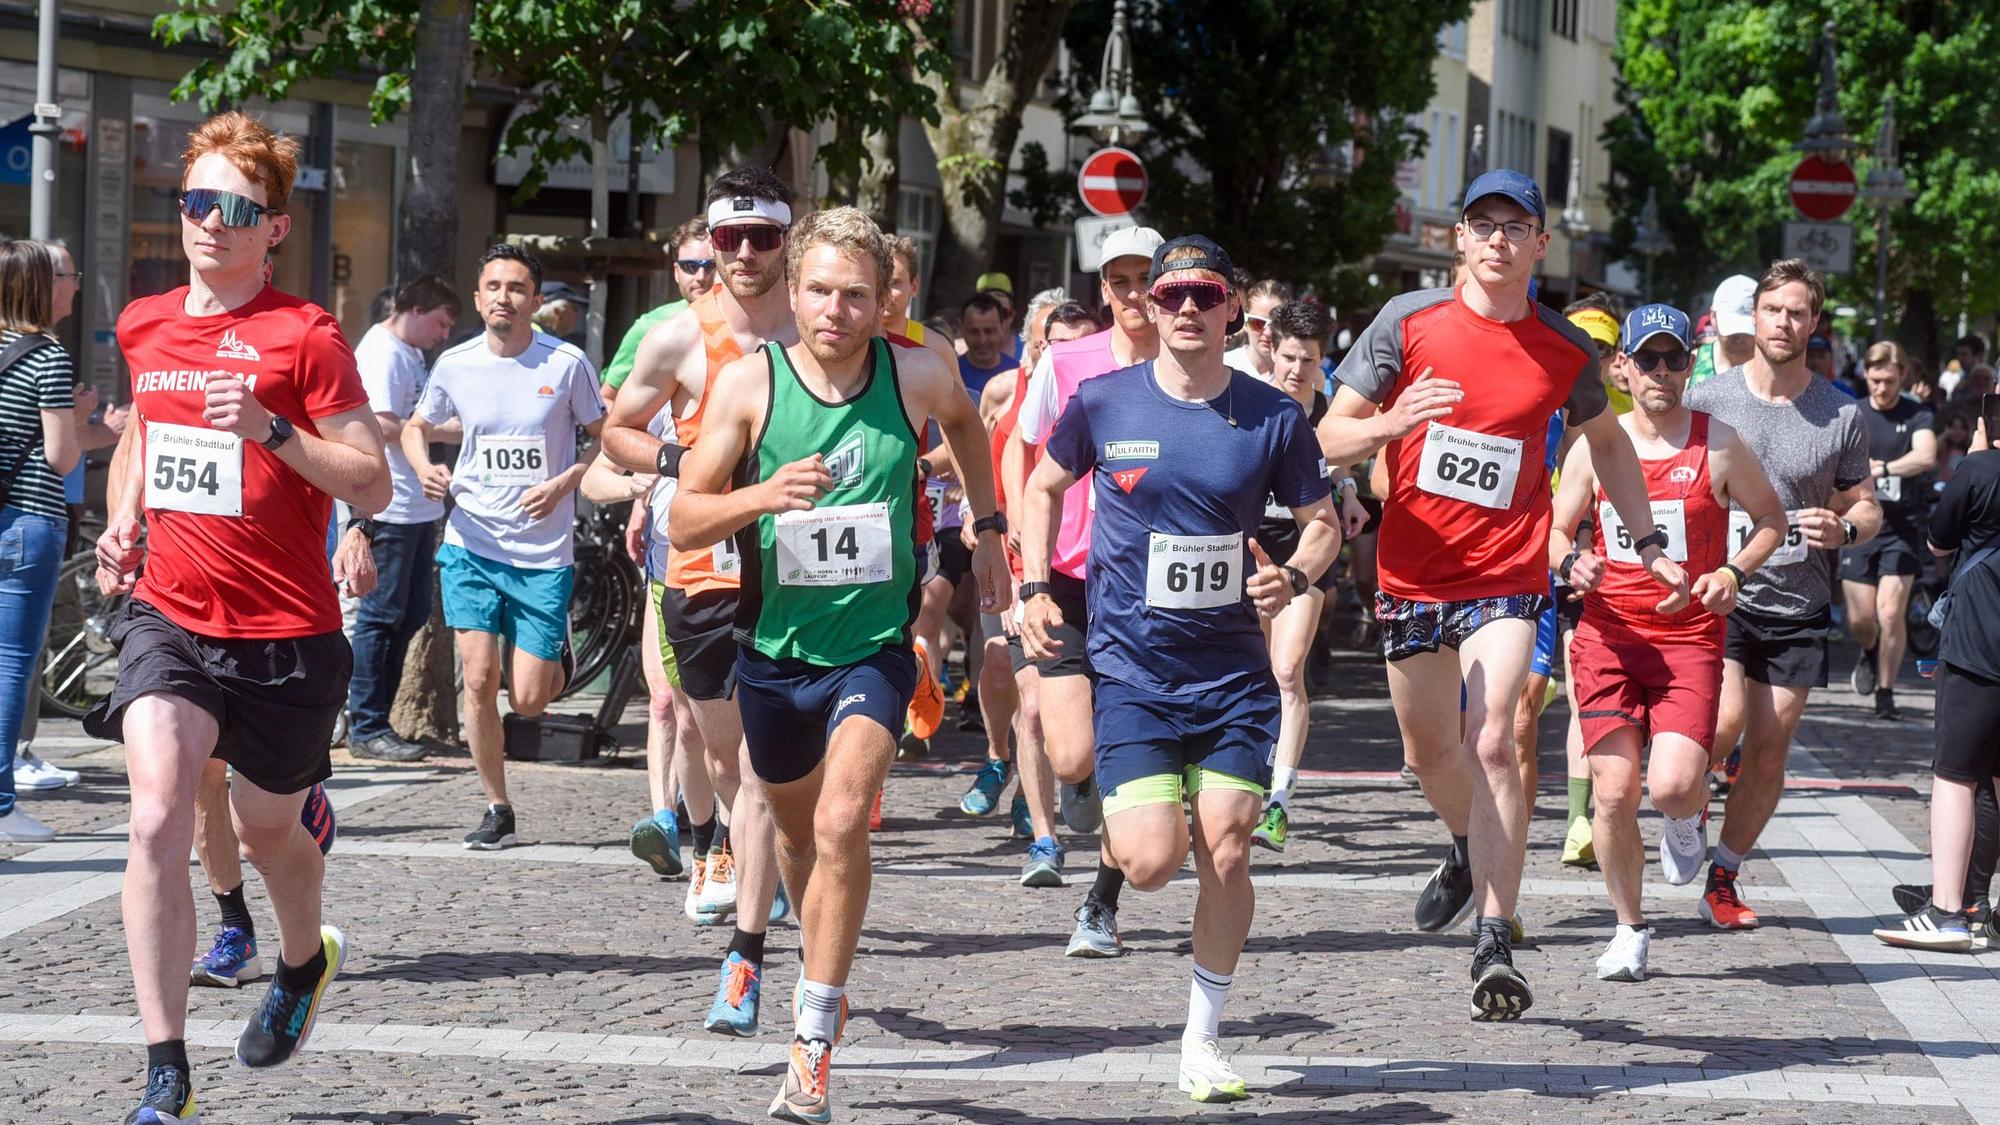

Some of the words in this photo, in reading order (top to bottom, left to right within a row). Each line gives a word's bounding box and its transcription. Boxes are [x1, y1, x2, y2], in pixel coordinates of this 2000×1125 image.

[163, 433, 194, 446] Brühler
[195, 438, 235, 450] Stadtlauf
[1448, 435, 1478, 449] Brühler
[1480, 442, 1516, 455] Stadtlauf
[482, 447, 542, 470] 1036
[154, 454, 219, 496] 554
[1120, 474, 1134, 485] PT
[1437, 452, 1501, 491] 626
[811, 526, 859, 562] 14
[1172, 544, 1205, 553] Brühler
[1206, 542, 1240, 553] Stadtlauf
[1167, 561, 1229, 593] 619
